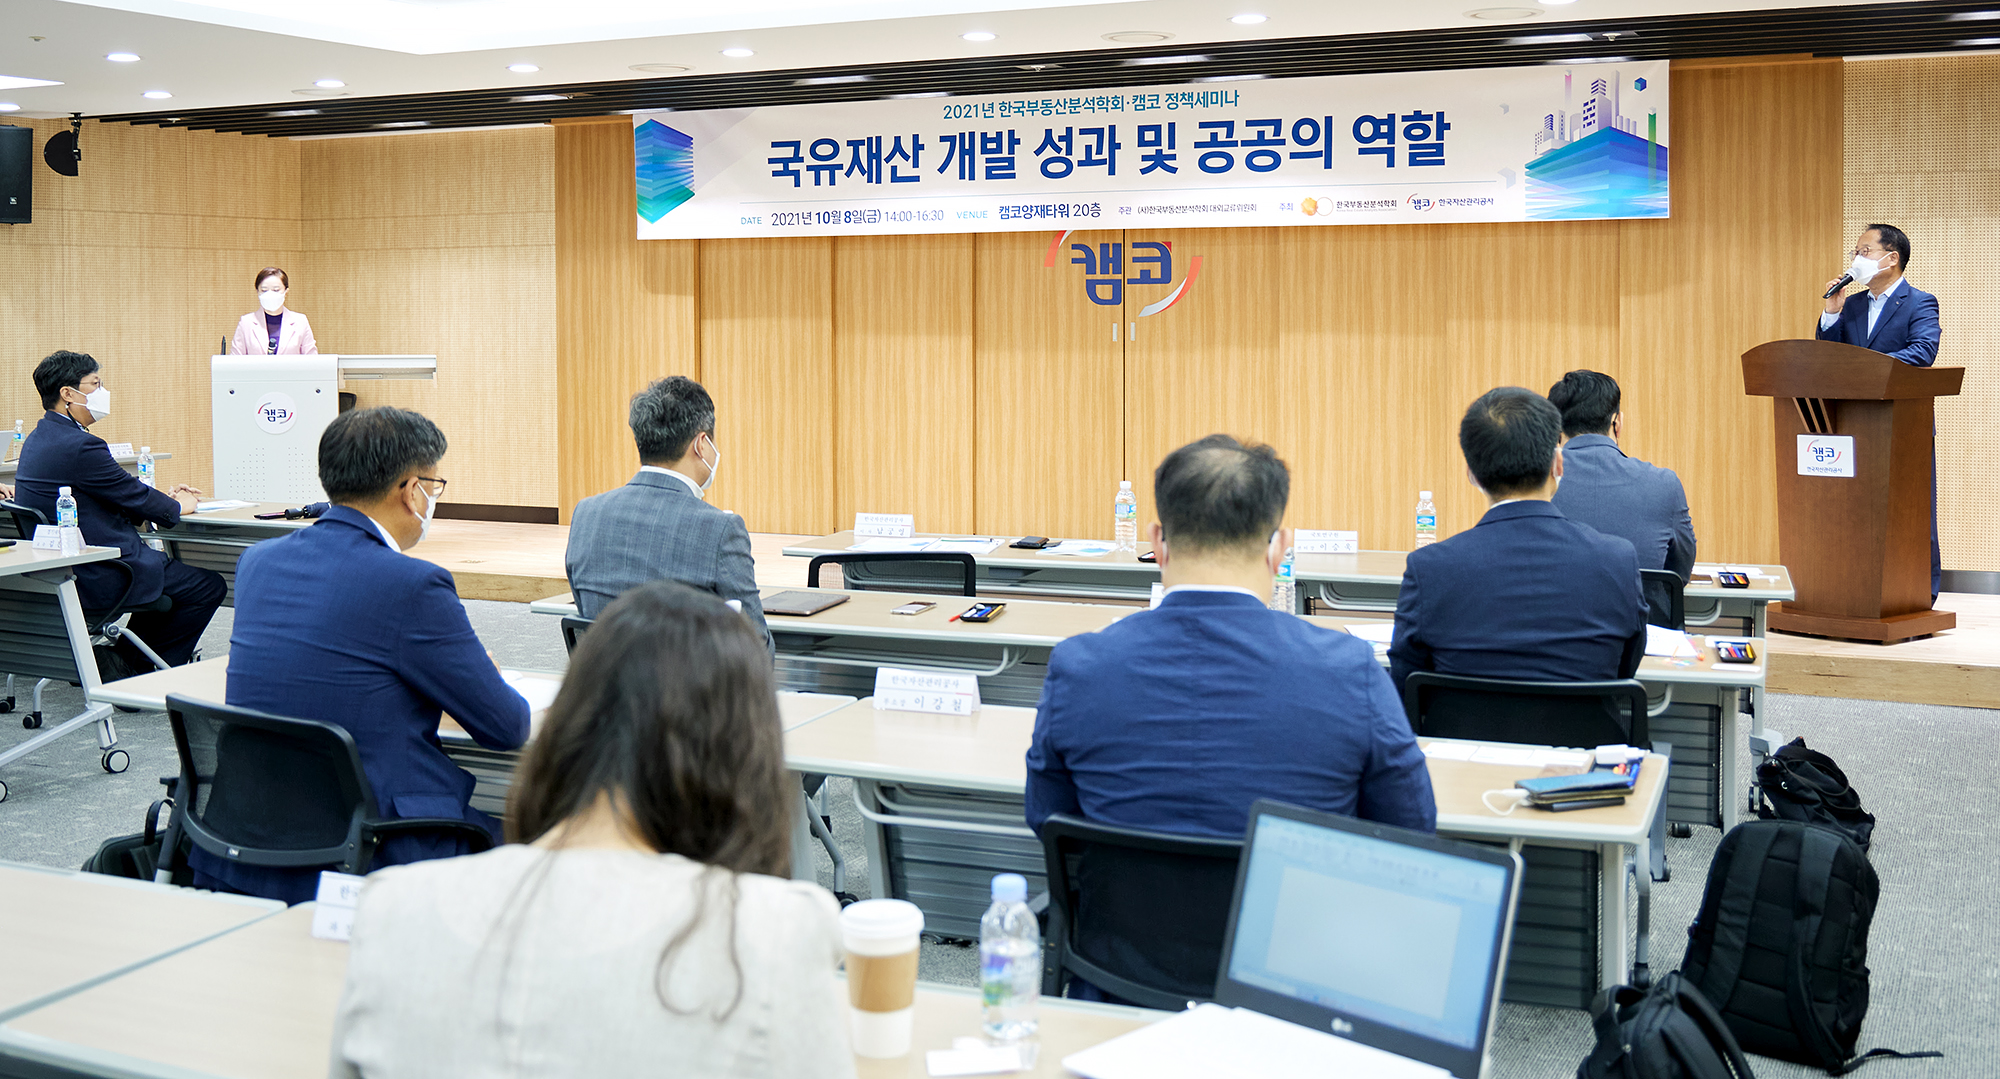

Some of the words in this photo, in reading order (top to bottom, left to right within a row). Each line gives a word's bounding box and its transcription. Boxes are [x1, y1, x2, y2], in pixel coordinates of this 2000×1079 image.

[942, 101, 995, 119] 2021년
[998, 92, 1162, 118] 한국부동산분석학회·캠코
[1165, 89, 1240, 109] 정책세미나
[767, 134, 925, 188] 국유재산
[937, 129, 1021, 181] 개발
[1033, 124, 1122, 180] 성과
[1137, 121, 1179, 176] 및
[1193, 115, 1333, 174] 공공의
[1352, 110, 1451, 168] 역할
[1336, 200, 1398, 209] 한국부동산분석학회
[1411, 198, 1431, 211] 캠코
[1438, 197, 1494, 207] 한국자산관리공사
[771, 211, 813, 226] 2021년
[815, 210, 842, 225] 10월
[844, 208, 882, 224] 8일(금)
[884, 209, 944, 222] 14:00-16:30
[956, 210, 989, 220] VENUE
[998, 203, 1070, 220] 캠코양재타워
[1073, 201, 1102, 218] 20층
[1118, 206, 1132, 215] 주관
[740, 216, 763, 226] DATE
[1071, 241, 1172, 306] 캠코
[263, 408, 287, 423] 캠코
[1812, 446, 1835, 462] 캠코
